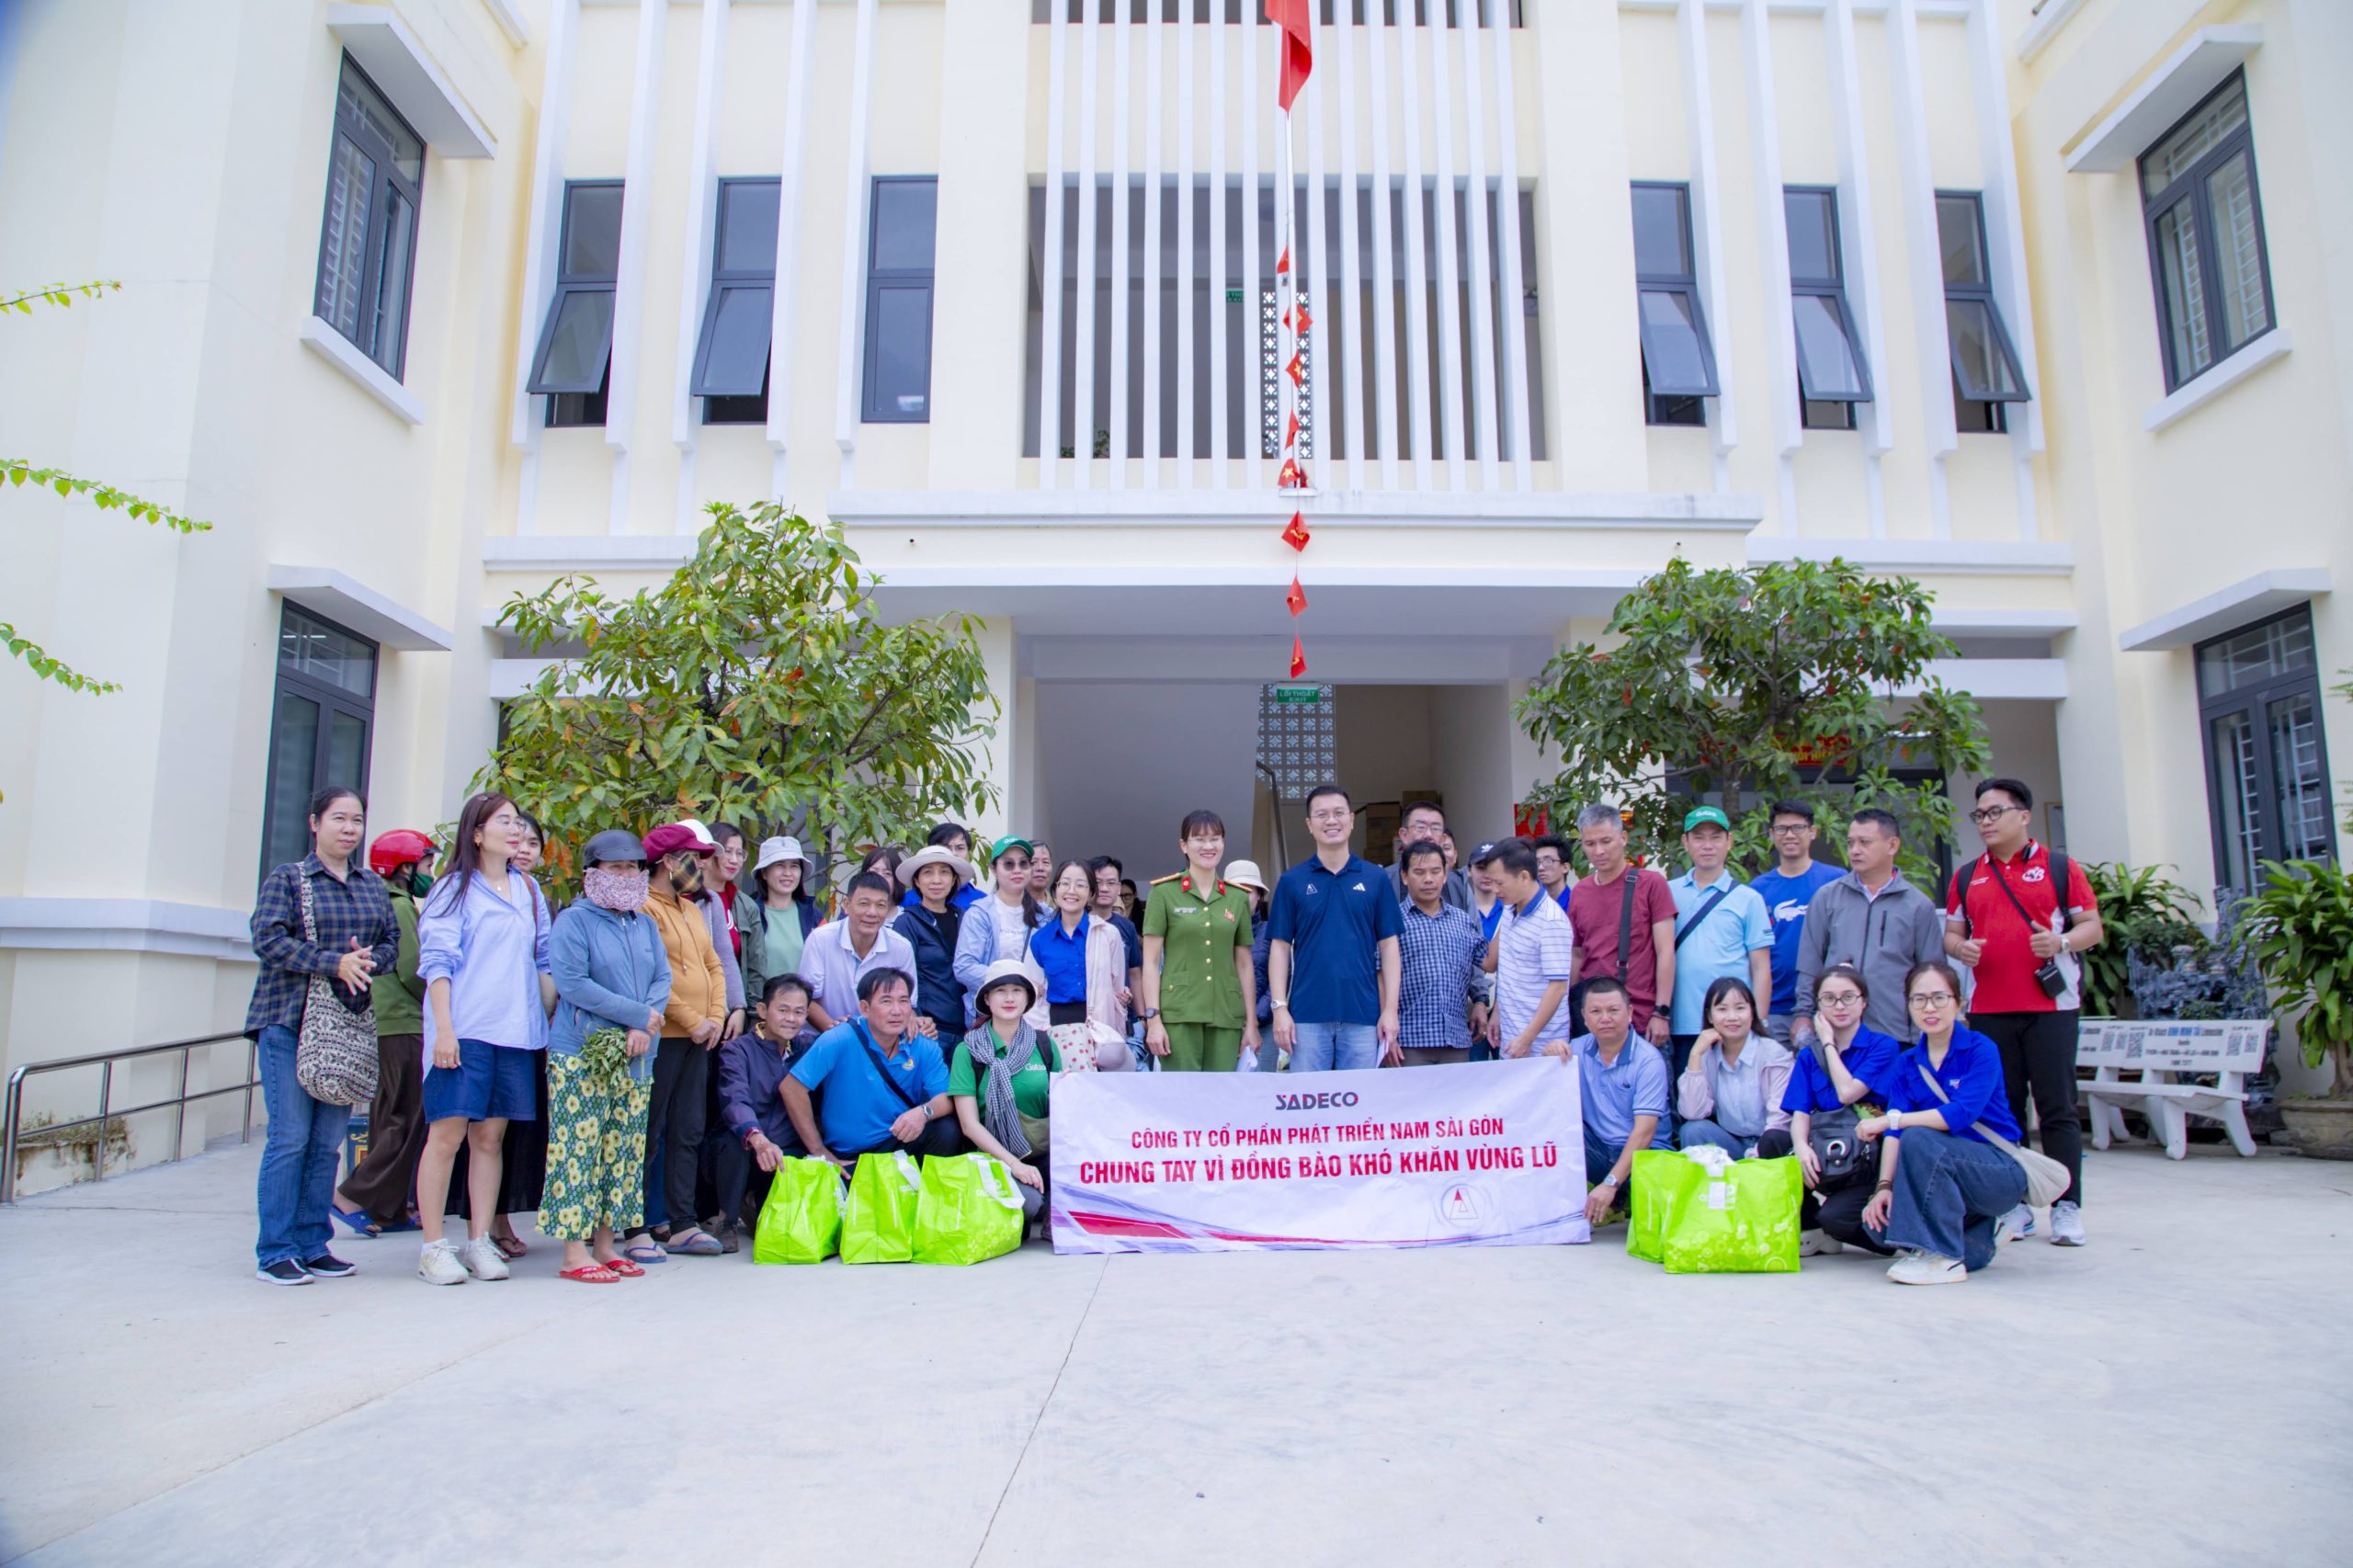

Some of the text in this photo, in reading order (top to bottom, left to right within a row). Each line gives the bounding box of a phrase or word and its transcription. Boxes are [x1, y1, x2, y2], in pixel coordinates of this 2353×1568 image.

[1276, 1091, 1358, 1110] SADECO
[1131, 1114, 1504, 1149] CÔNG TY CỔ PHẦN PHÁT TRIỂN NAM SÀI GÒN
[1080, 1141, 1557, 1185] CHUNG TAY VÌ ĐỒNG BÀO KHÓ KHĂN VÙNG LŨ
